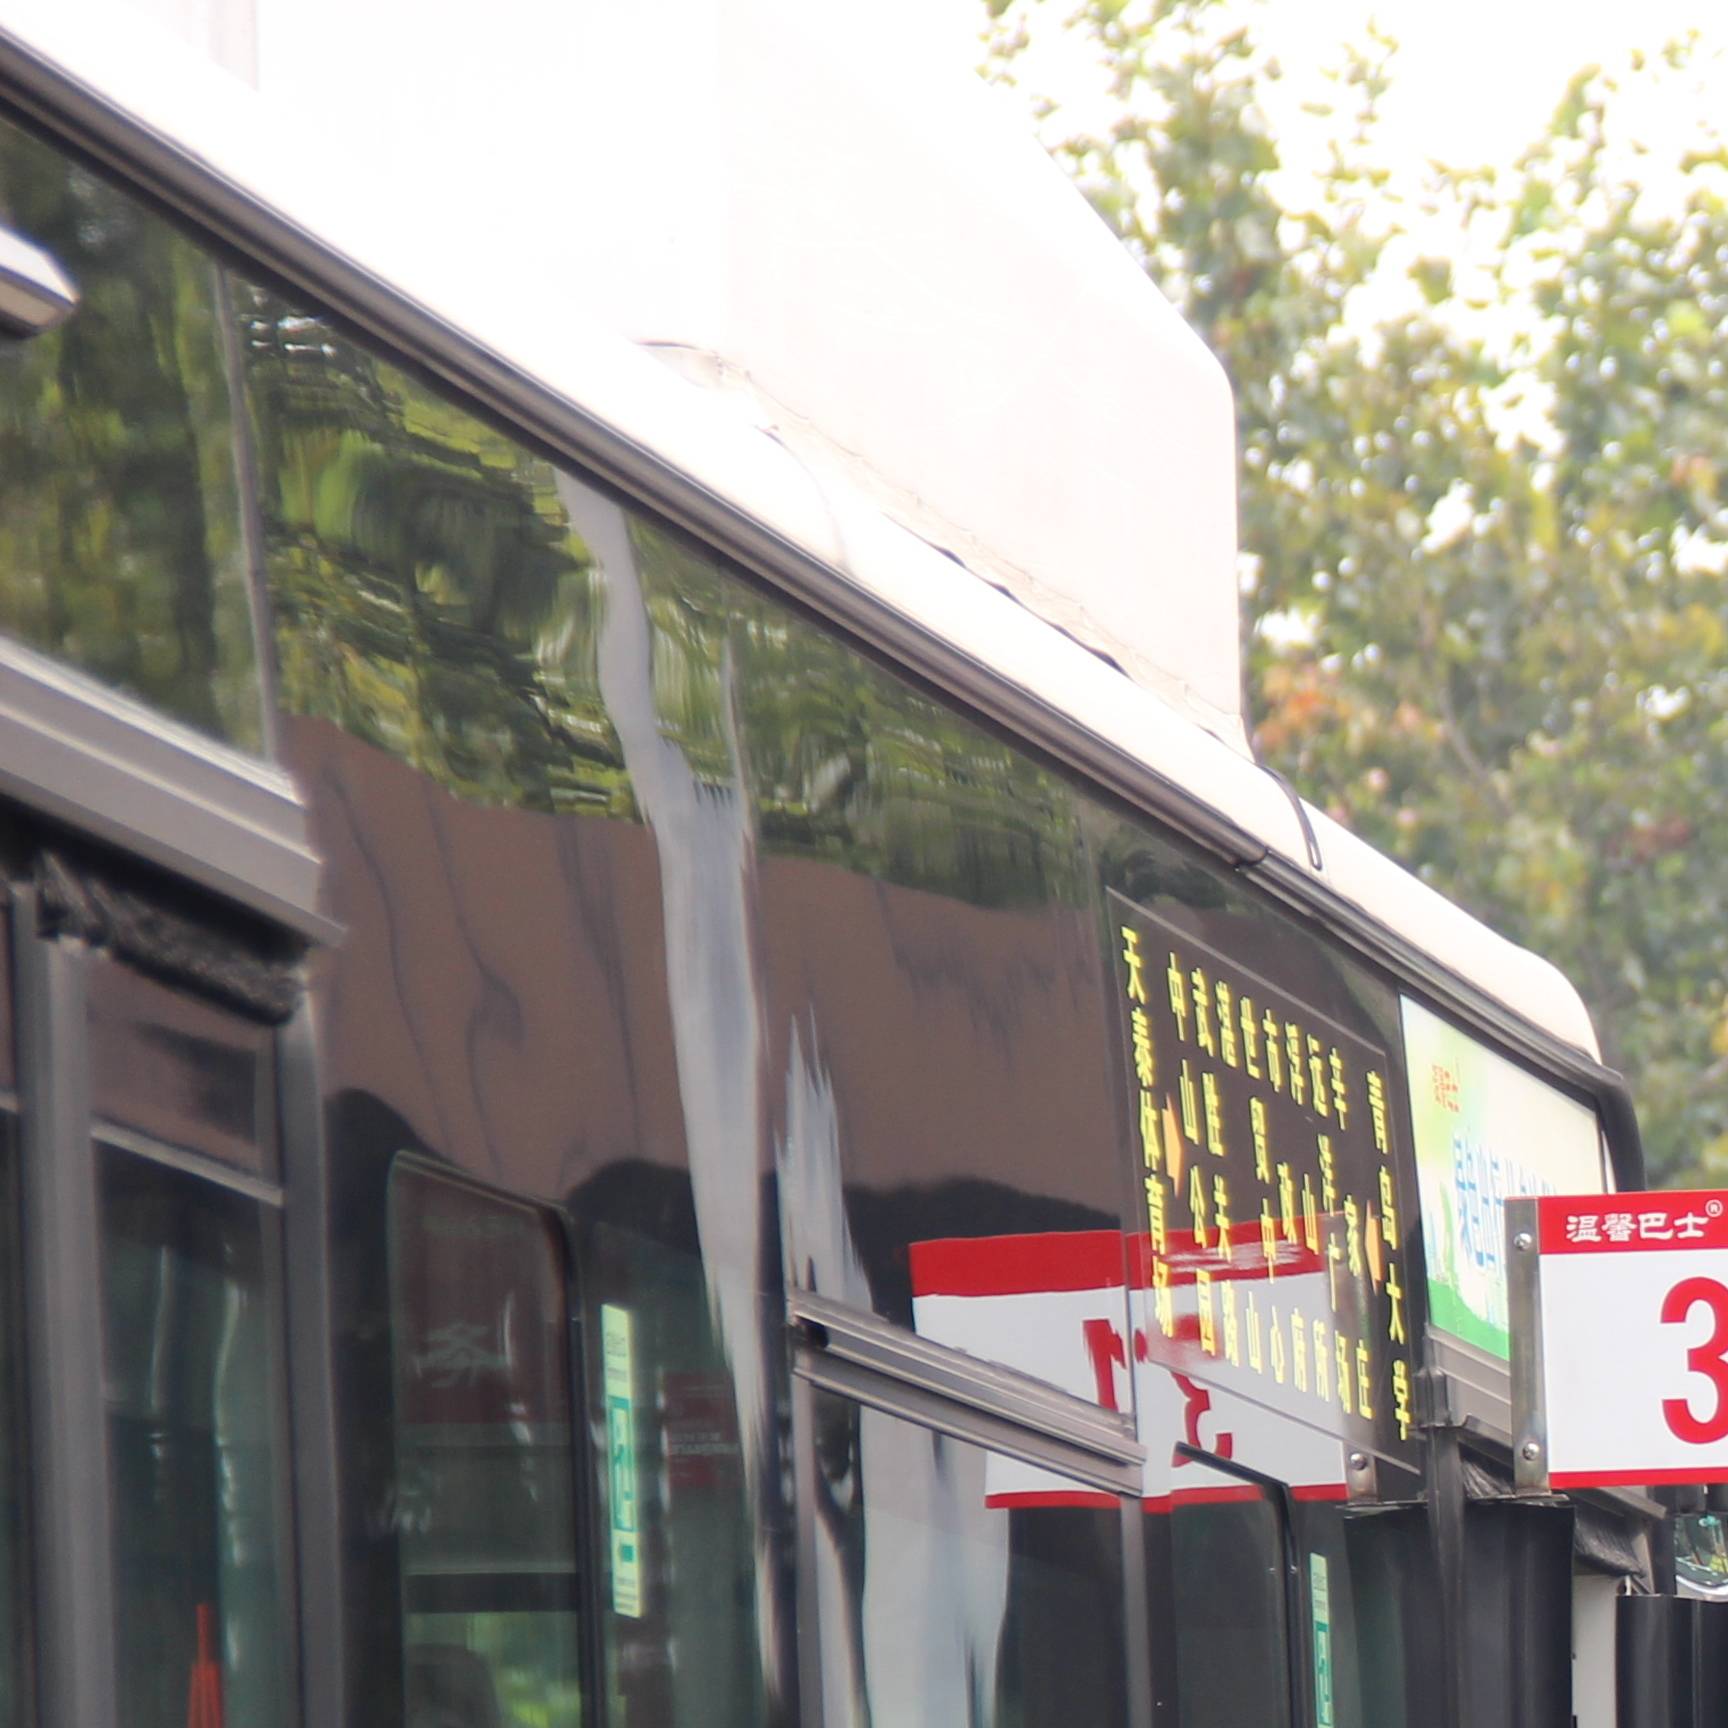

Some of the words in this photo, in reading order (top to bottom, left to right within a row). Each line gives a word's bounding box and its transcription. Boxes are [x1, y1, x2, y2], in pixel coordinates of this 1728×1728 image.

[1122, 926, 1174, 1337] 天泰体育场
[1167, 950, 1216, 1356] 中山公园
[1367, 1070, 1409, 1441] 青岛大学
